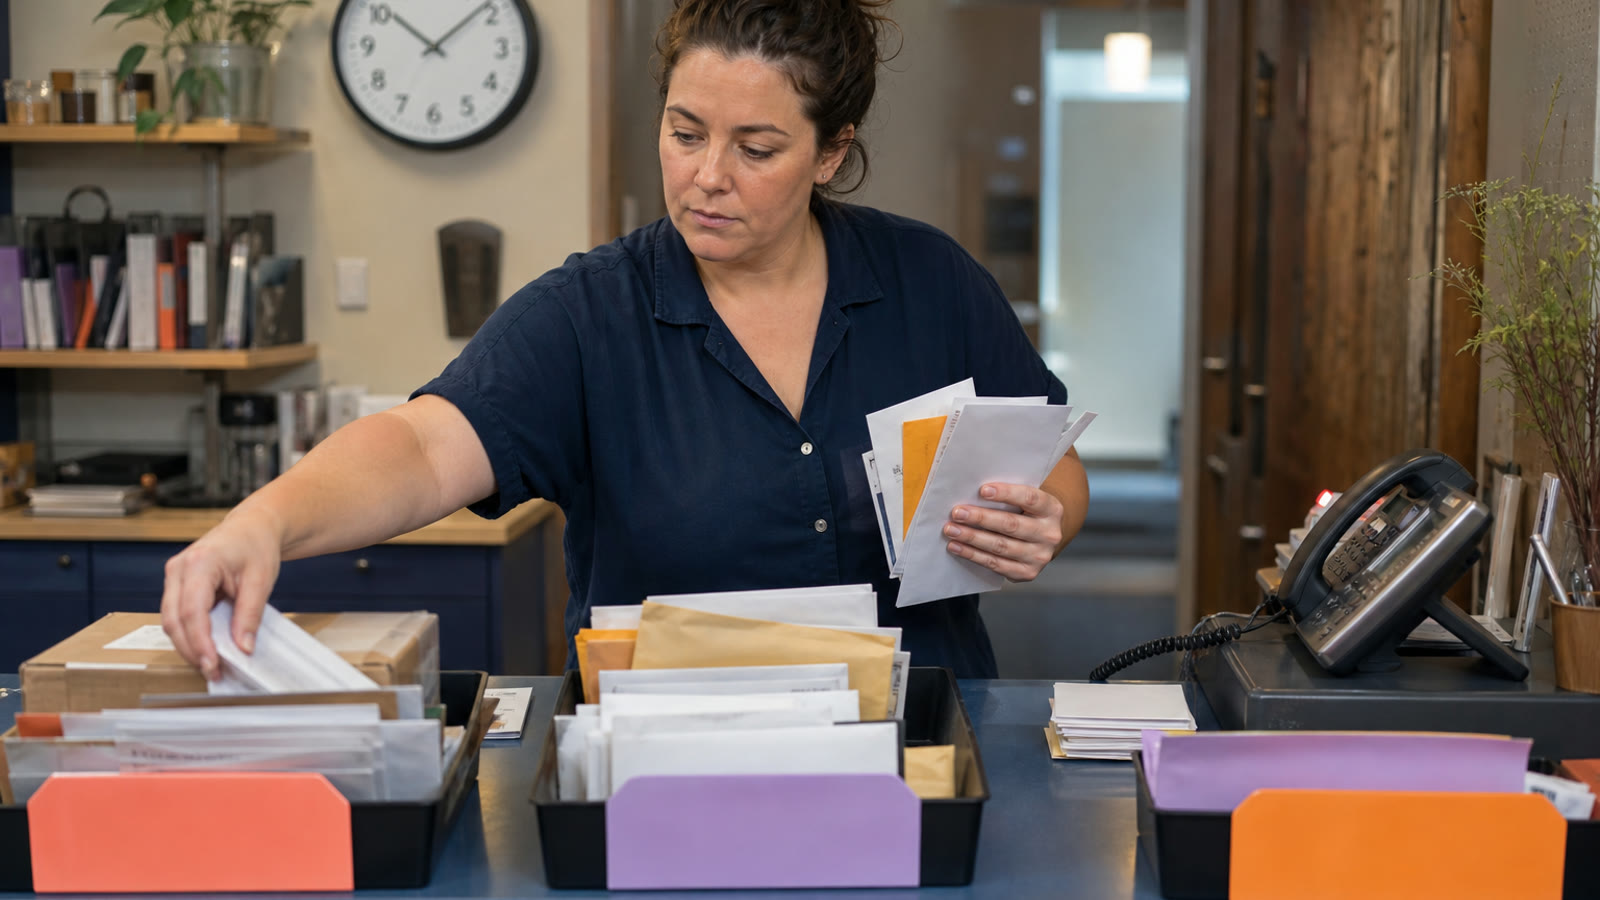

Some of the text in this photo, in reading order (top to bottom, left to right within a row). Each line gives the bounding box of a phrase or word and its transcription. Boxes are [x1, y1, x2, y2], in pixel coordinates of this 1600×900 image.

[370, 4, 391, 24] 10
[484, 4, 499, 25] 2
[360, 35, 376, 57] 9
[494, 37, 509, 59] 3
[371, 69, 386, 91] 8
[482, 71, 498, 92] 4
[395, 94, 409, 114] 7
[426, 102, 442, 125] 6
[460, 95, 475, 117] 5
